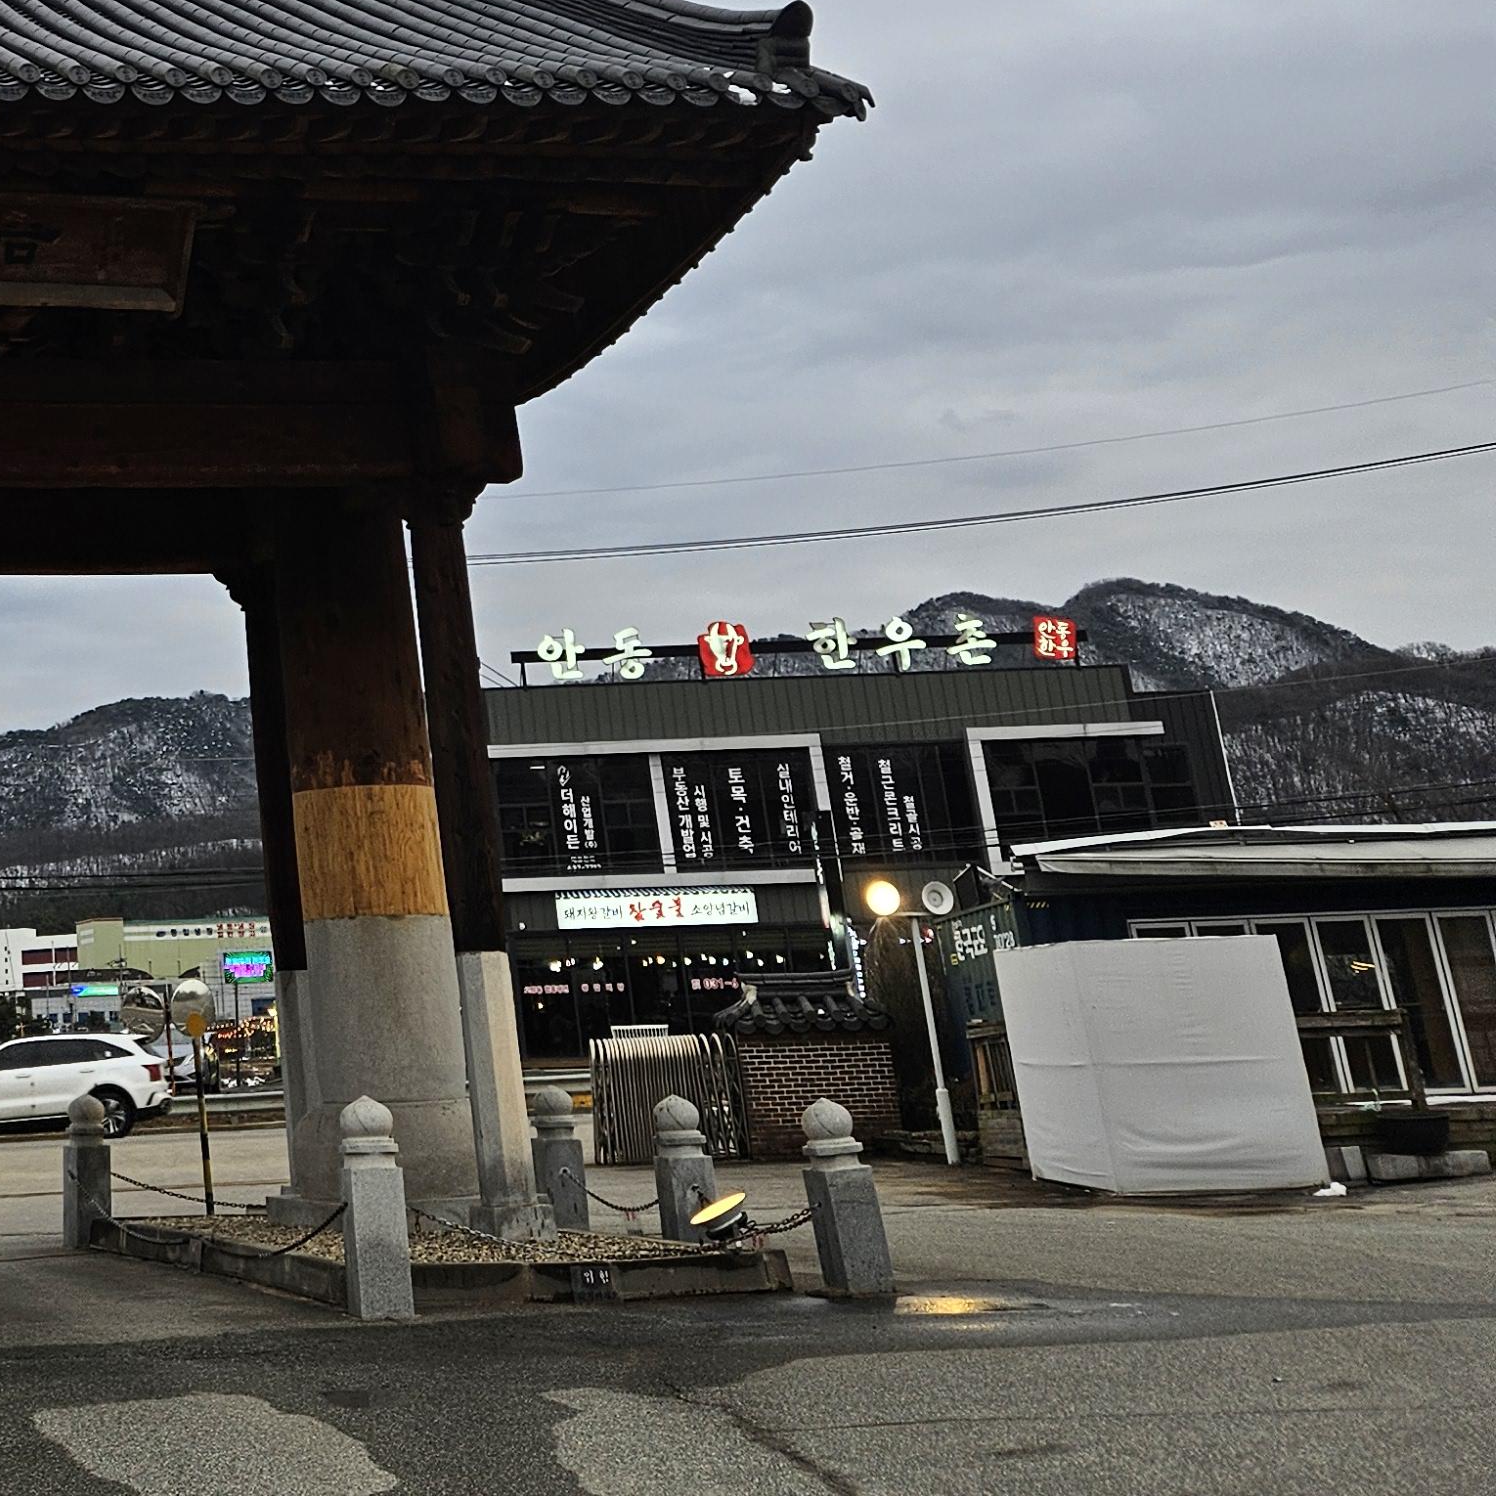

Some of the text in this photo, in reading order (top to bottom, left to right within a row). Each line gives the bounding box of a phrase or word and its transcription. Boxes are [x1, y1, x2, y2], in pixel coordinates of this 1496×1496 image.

[537, 613, 997, 680] 안동 한우촌
[1036, 635, 1074, 658] 한우
[1037, 619, 1072, 641] 안동
[673, 767, 697, 859] 부동산 개발업
[694, 784, 715, 860] 시행 및 시공
[777, 762, 803, 854] 실내인테리어
[878, 759, 906, 852] 철근콘크리트
[903, 795, 923, 850] 철골시공
